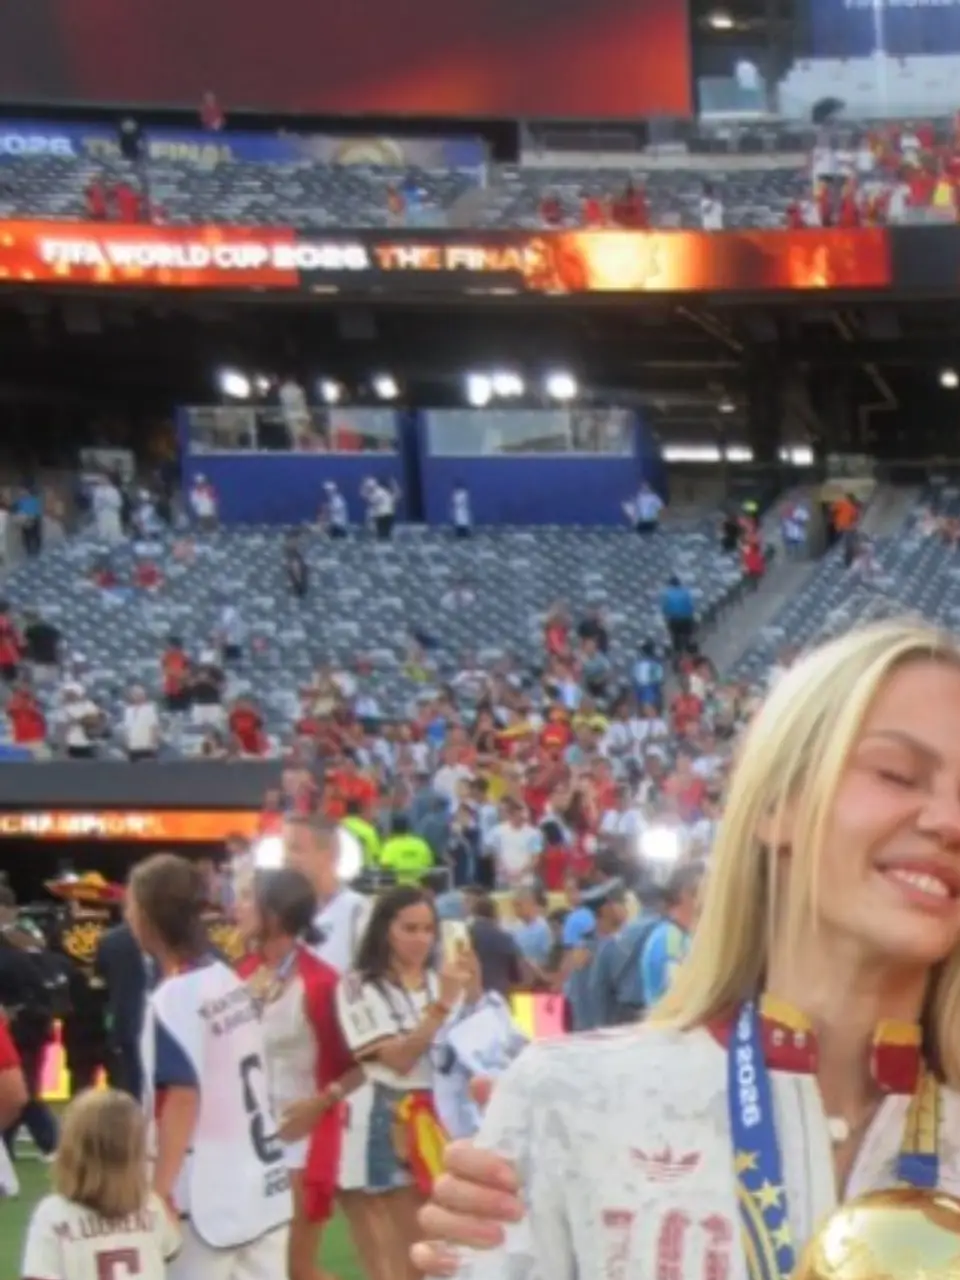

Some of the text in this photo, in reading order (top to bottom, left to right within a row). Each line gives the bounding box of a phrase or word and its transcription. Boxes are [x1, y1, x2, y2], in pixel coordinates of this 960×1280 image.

[0, 134, 70, 155] 026
[40, 238, 101, 265] FIFA
[105, 242, 208, 268] WORLD
[213, 244, 269, 269] CUP
[272, 244, 369, 270] 2026
[376, 246, 440, 271] THE
[737, 1043, 761, 1128] 2026
